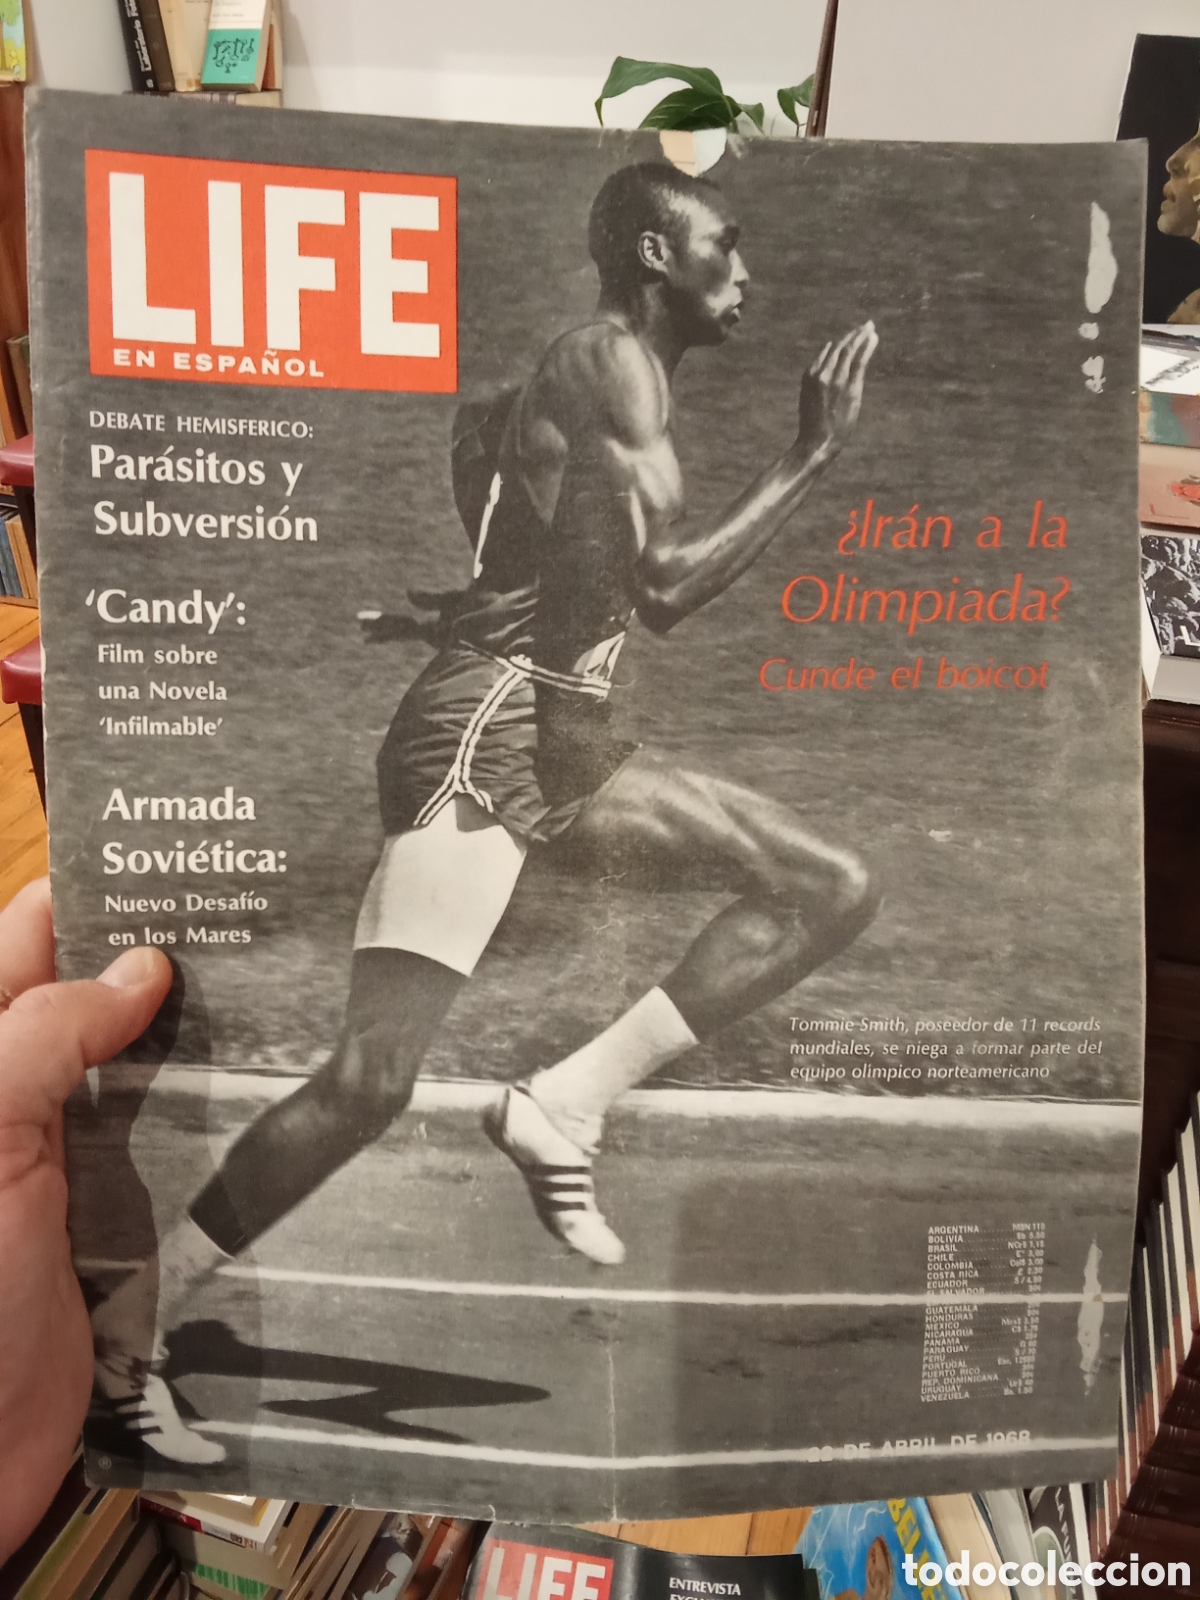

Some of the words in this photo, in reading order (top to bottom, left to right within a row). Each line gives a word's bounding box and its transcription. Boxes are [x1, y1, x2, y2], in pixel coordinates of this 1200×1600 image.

[109, 171, 440, 358] LIFE
[113, 349, 156, 368] EN
[173, 349, 325, 378] ESPAÑOL
[89, 411, 165, 431] DEBATE
[176, 416, 314, 438] HEMISFERICO:
[91, 444, 266, 485] Parásitos
[280, 462, 303, 496] y
[94, 500, 318, 541] Subversión
[837, 498, 953, 556] ¿Irán
[976, 515, 1003, 549] a
[1028, 499, 1068, 549] la
[781, 572, 1071, 636] Olimpiada?
[98, 643, 144, 664] Film
[154, 644, 218, 665] sobre
[759, 657, 876, 691] Cunde
[890, 656, 923, 689] el
[936, 656, 1050, 690] boicot
[98, 684, 140, 700] una
[150, 681, 227, 700] Novela
[101, 786, 256, 821] Armada
[101, 839, 288, 875] Soviética:
[105, 895, 177, 913] Nuevo
[186, 891, 269, 912] Desafío
[108, 931, 136, 946] en
[144, 927, 177, 945] los
[186, 926, 252, 944] Mares
[789, 1016, 854, 1032] Tommie
[860, 1017, 909, 1034] Smith,
[915, 1016, 989, 1035] poseedor
[994, 1017, 1013, 1032] de
[1020, 1018, 1037, 1032] 11
[1044, 1016, 1101, 1032] records
[790, 1040, 875, 1058] mundiales,
[882, 1044, 899, 1055] se
[906, 1041, 948, 1059] niega
[955, 1044, 965, 1055] a
[1030, 1042, 1071, 1058] parte
[1077, 1040, 1103, 1055] del
[790, 1064, 846, 1082] equipo
[927, 1064, 1050, 1078] norteamericano
[928, 1225, 979, 1235] ARGENTINA
[928, 1235, 963, 1244] BOLIVIA
[927, 1253, 954, 1262] CHILE
[928, 1244, 958, 1253] BRASIL
[927, 1261, 974, 1271] COLOMBIA
[927, 1271, 955, 1280] COSTA
[927, 1279, 968, 1289] ECUADOR
[950, 1433, 977, 1451] DE
[483, 1547, 606, 1600] LIFE
[669, 1577, 741, 1596] ENTREVISTA
